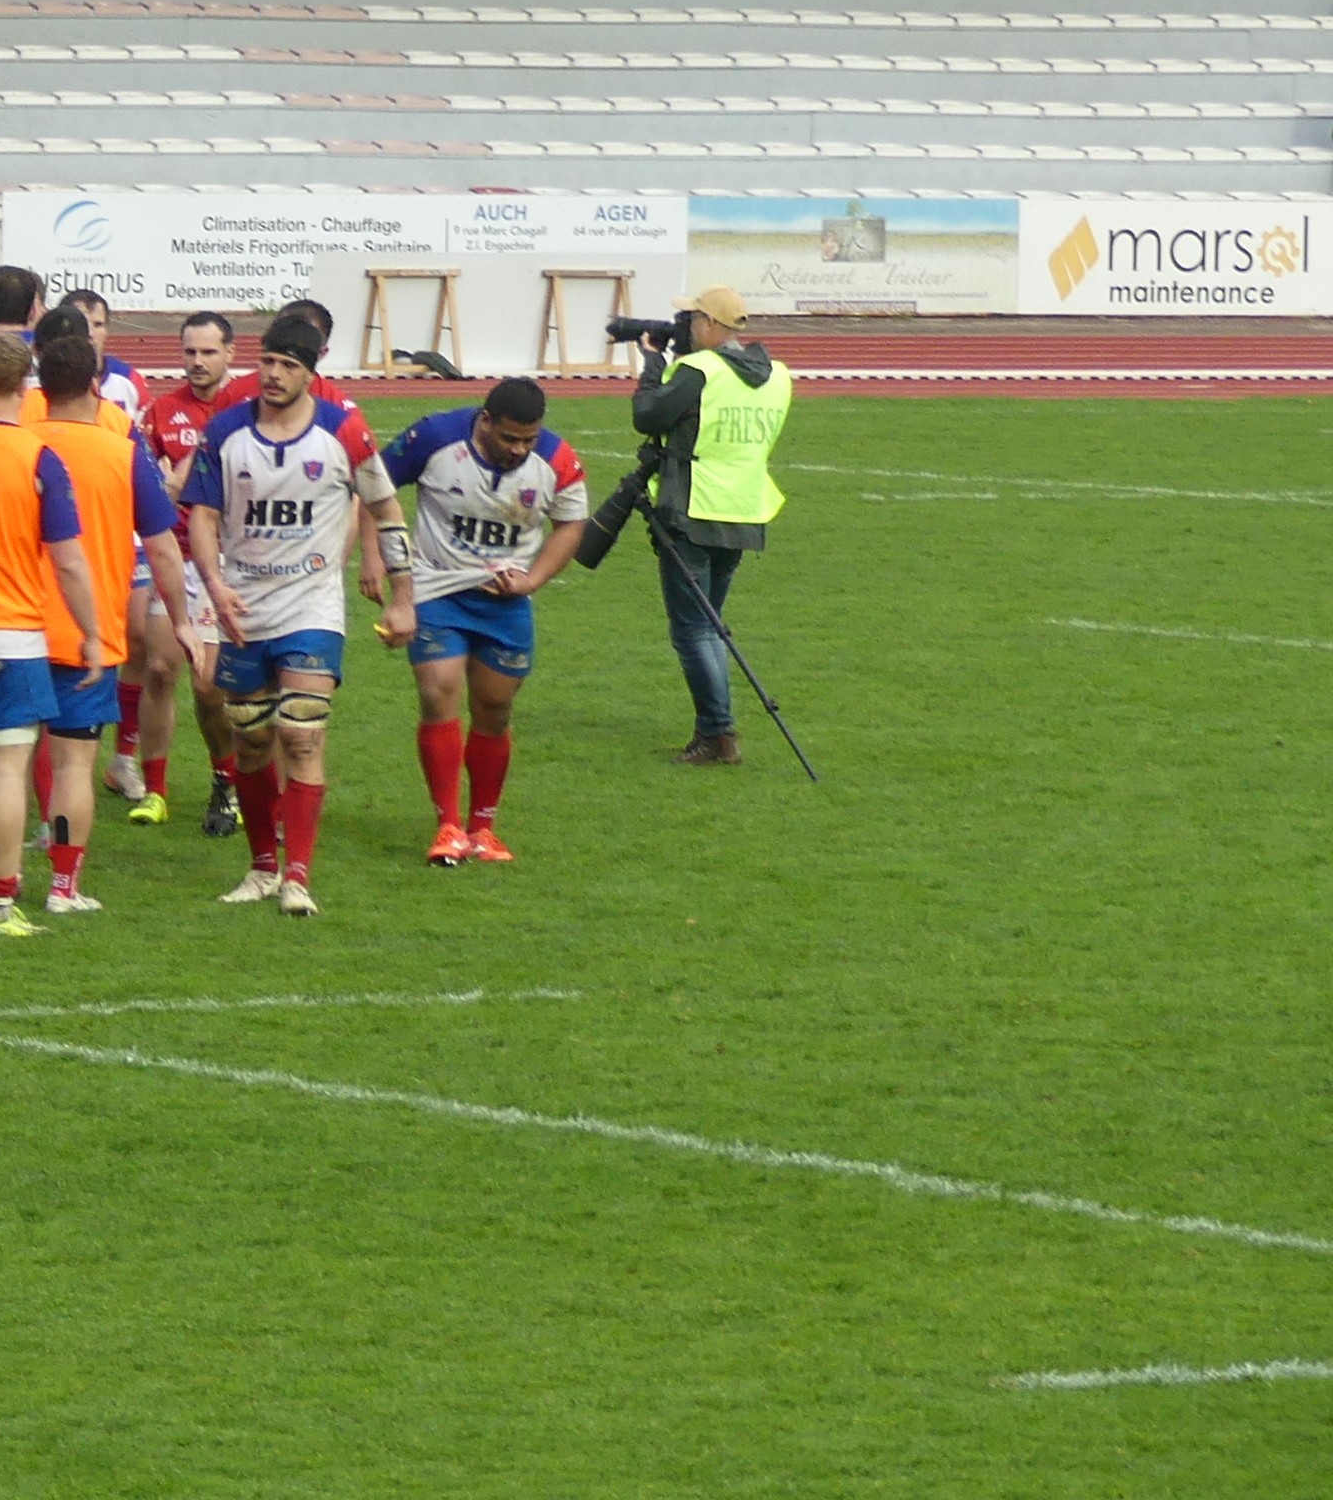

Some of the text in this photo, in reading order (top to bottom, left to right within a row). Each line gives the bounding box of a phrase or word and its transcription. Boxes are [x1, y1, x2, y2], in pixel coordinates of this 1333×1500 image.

[473, 204, 529, 222] AUCH
[593, 204, 649, 222] AGEN
[202, 216, 306, 233] Climatisation
[321, 216, 402, 235] Chauffage
[170, 238, 245, 255] Matériels
[193, 260, 276, 277] Ventilation
[760, 263, 855, 291] Restaurant
[884, 262, 954, 286] Traiteur
[165, 281, 265, 301] Dépannages
[1109, 279, 1276, 304] maintenance
[244, 499, 314, 526] HBI
[452, 514, 522, 548] HBI
